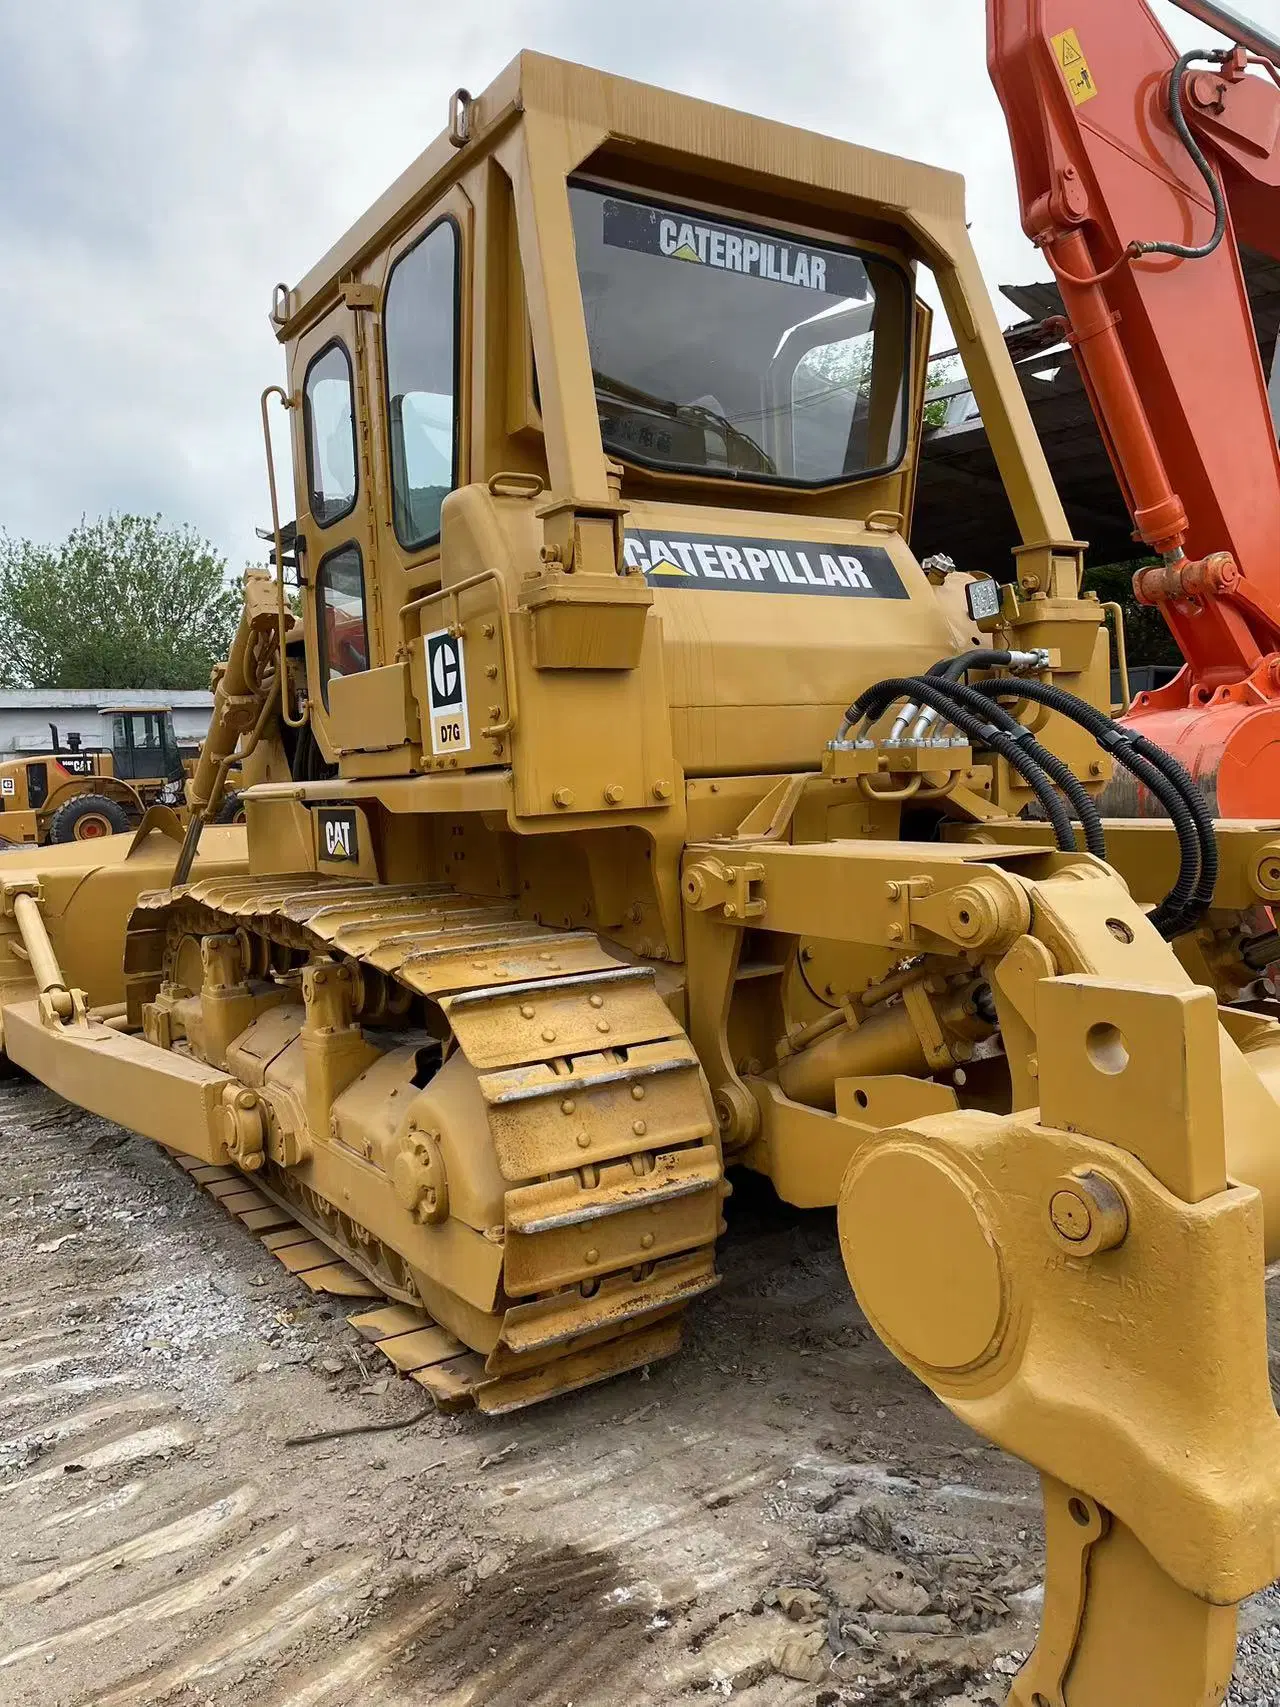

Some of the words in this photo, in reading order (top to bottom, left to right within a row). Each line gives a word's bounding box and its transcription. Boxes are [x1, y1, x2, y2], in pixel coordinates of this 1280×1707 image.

[660, 218, 826, 291] CATERPILLAR
[624, 538, 872, 589] CATERPILLAR
[440, 723, 461, 743] D7G
[325, 821, 350, 856] CAT
